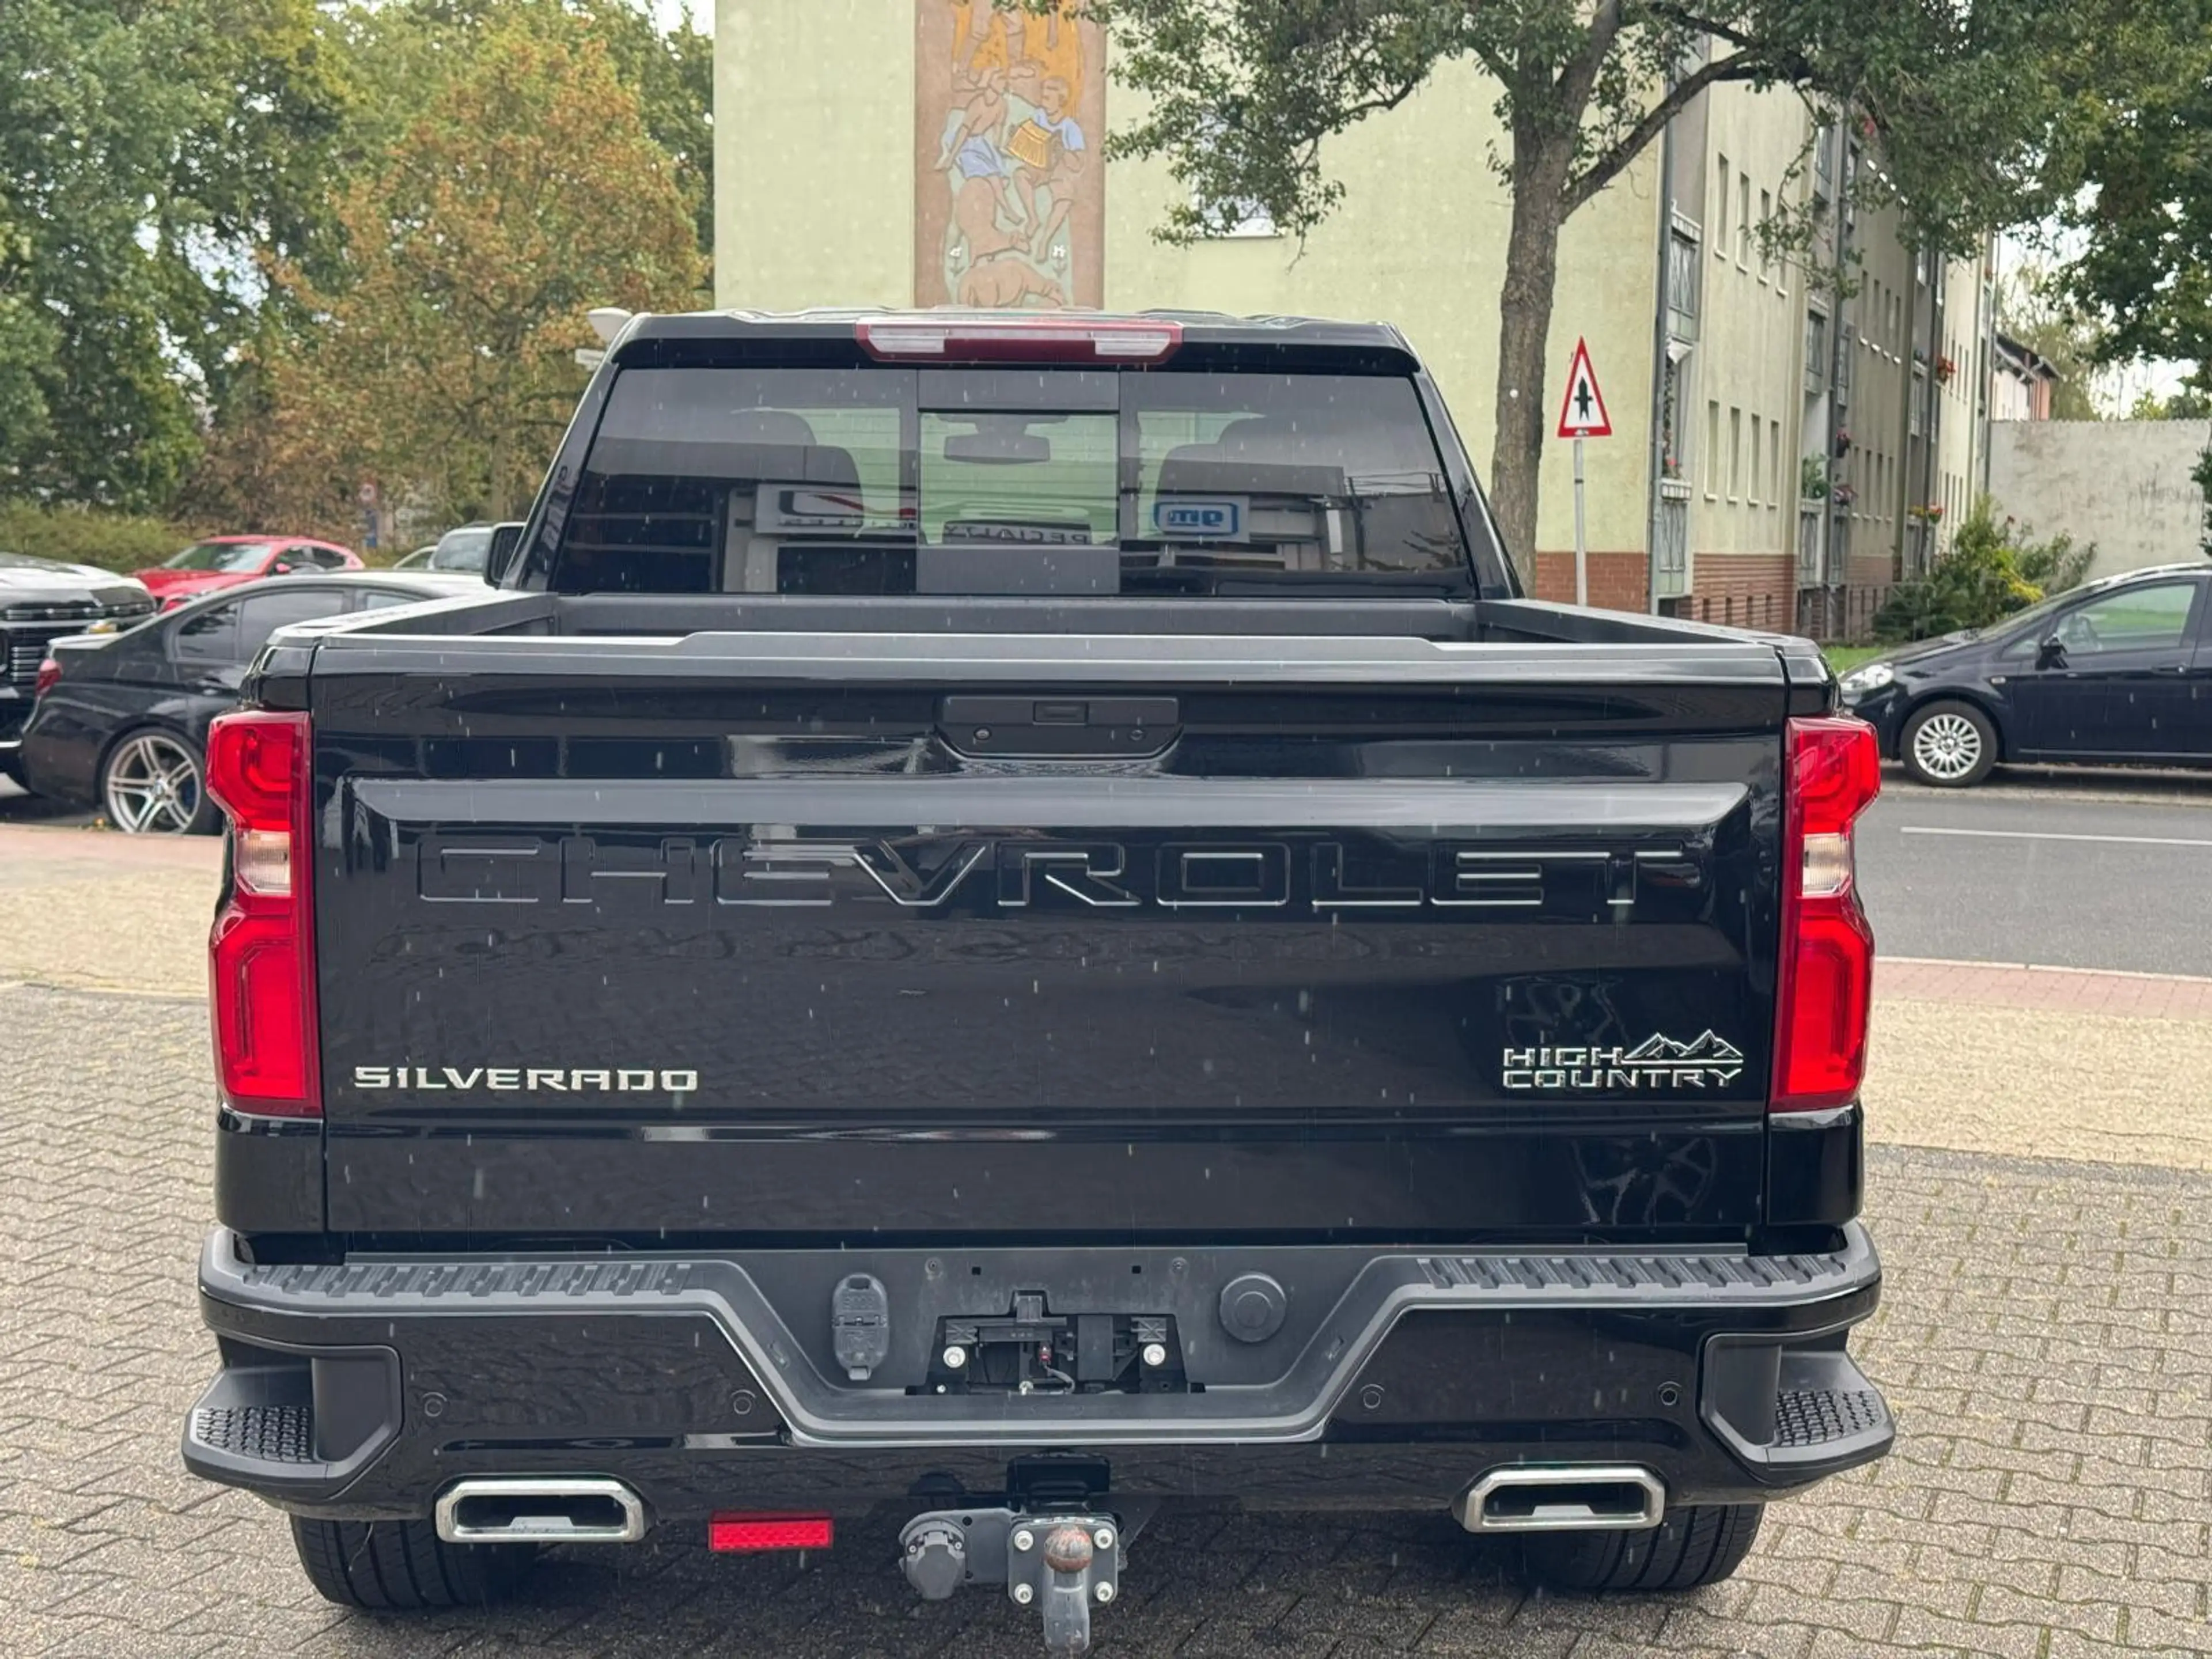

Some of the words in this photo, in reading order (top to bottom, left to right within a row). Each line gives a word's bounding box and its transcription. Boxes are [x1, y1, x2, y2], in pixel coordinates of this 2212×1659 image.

[416, 836, 1683, 905] CHEVROLET
[1503, 1047, 1624, 1067] HIGH
[354, 1067, 698, 1090] SILVERADO
[1503, 1069, 1742, 1088] COUNTRY
